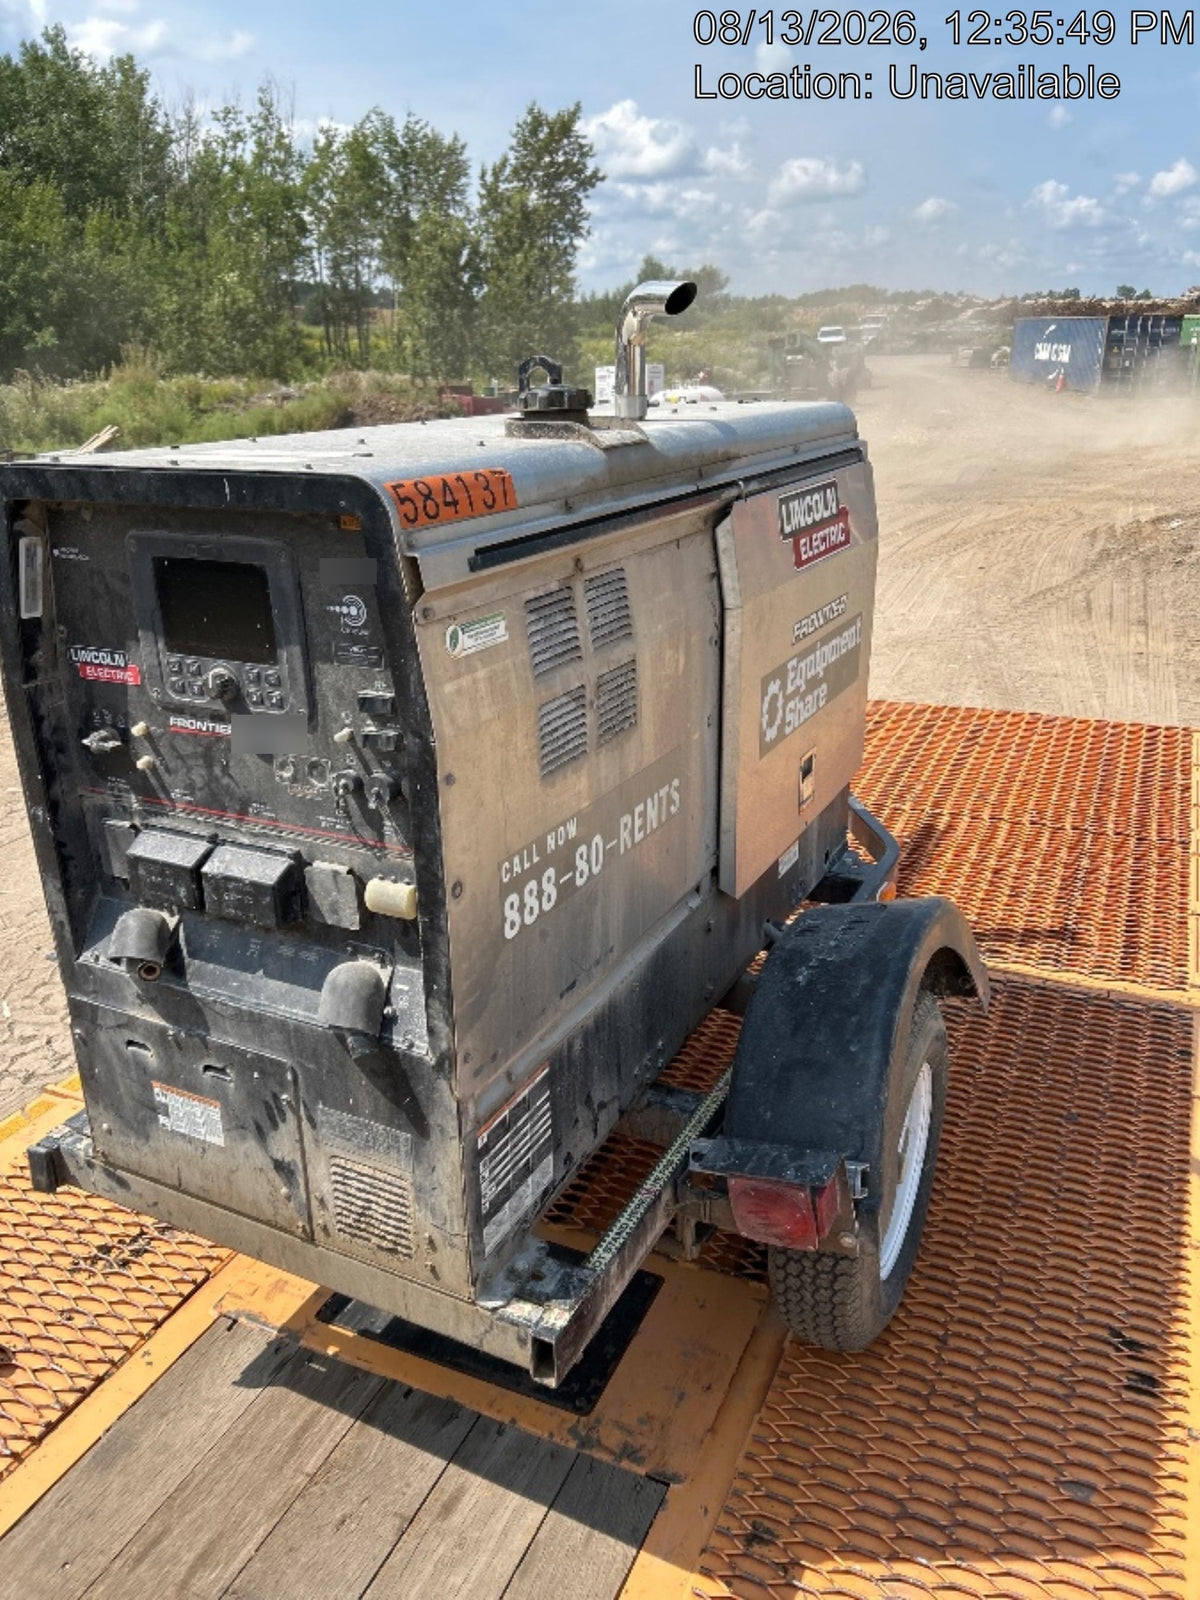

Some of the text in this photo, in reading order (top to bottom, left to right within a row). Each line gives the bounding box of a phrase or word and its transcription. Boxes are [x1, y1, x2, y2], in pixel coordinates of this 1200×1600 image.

[391, 470, 510, 524] 584137
[781, 486, 838, 534] LINCOLN
[800, 522, 846, 561] ELECTRIC
[70, 648, 126, 667] LINCOLN
[86, 666, 135, 682] ELECTRIC
[786, 615, 862, 696] Equipment
[169, 716, 232, 735] FRONTIE
[784, 682, 828, 736] Share
[502, 817, 577, 883] CALL NOW
[504, 778, 680, 940] 888-80-RENTS
